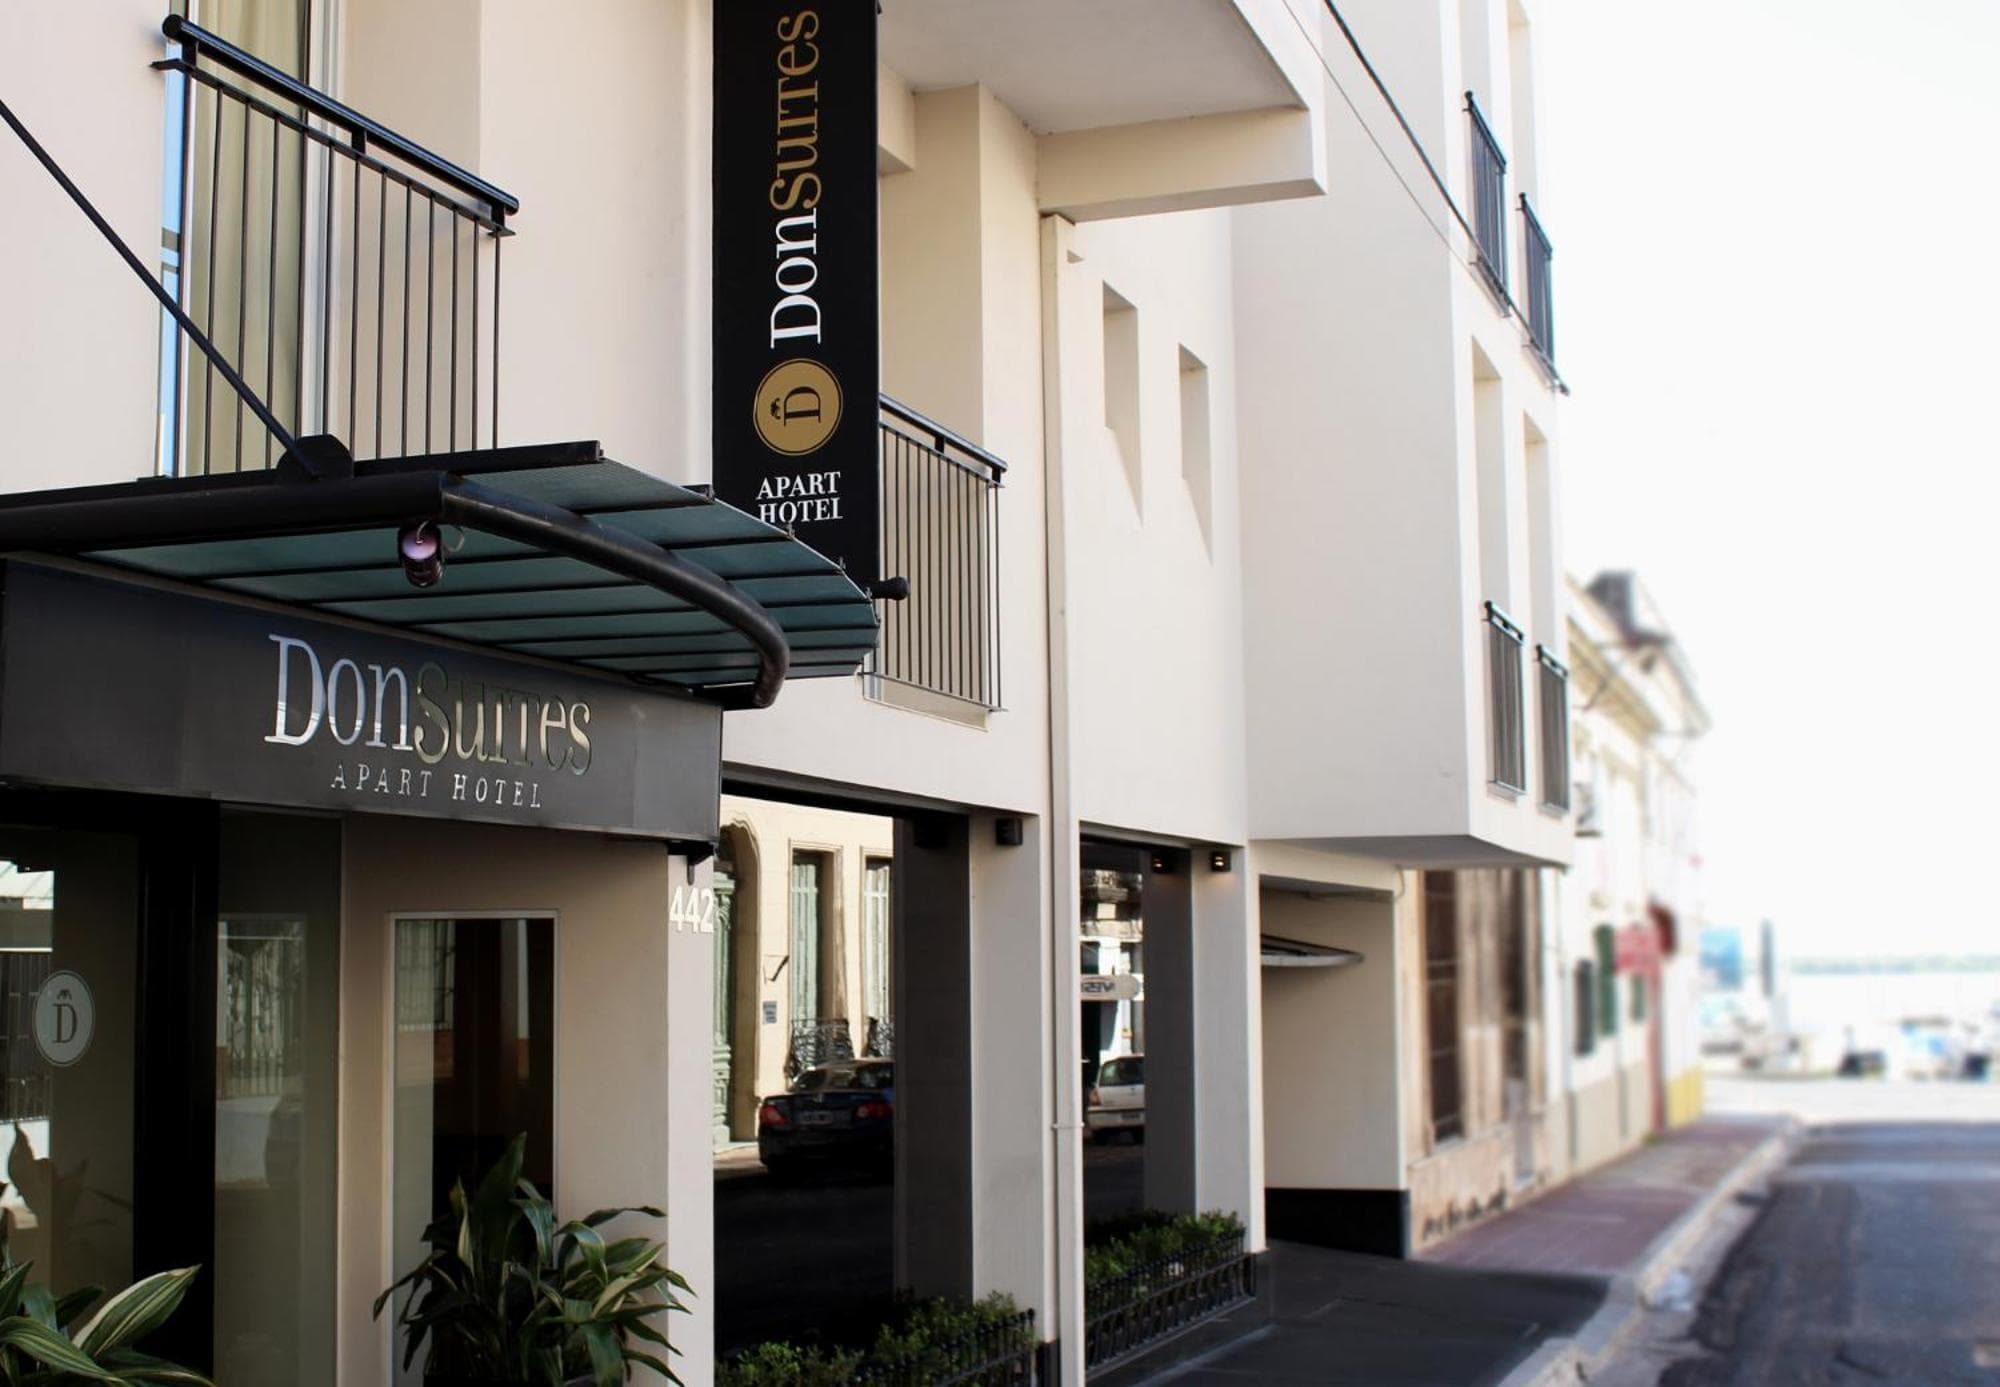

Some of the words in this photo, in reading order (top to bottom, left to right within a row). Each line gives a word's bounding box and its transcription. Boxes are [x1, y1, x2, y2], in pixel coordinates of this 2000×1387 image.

[756, 471, 841, 500] APART
[758, 497, 844, 523] HOTEL
[331, 764, 432, 797] APART
[452, 773, 541, 808] HOTEL
[669, 886, 715, 933] 442
